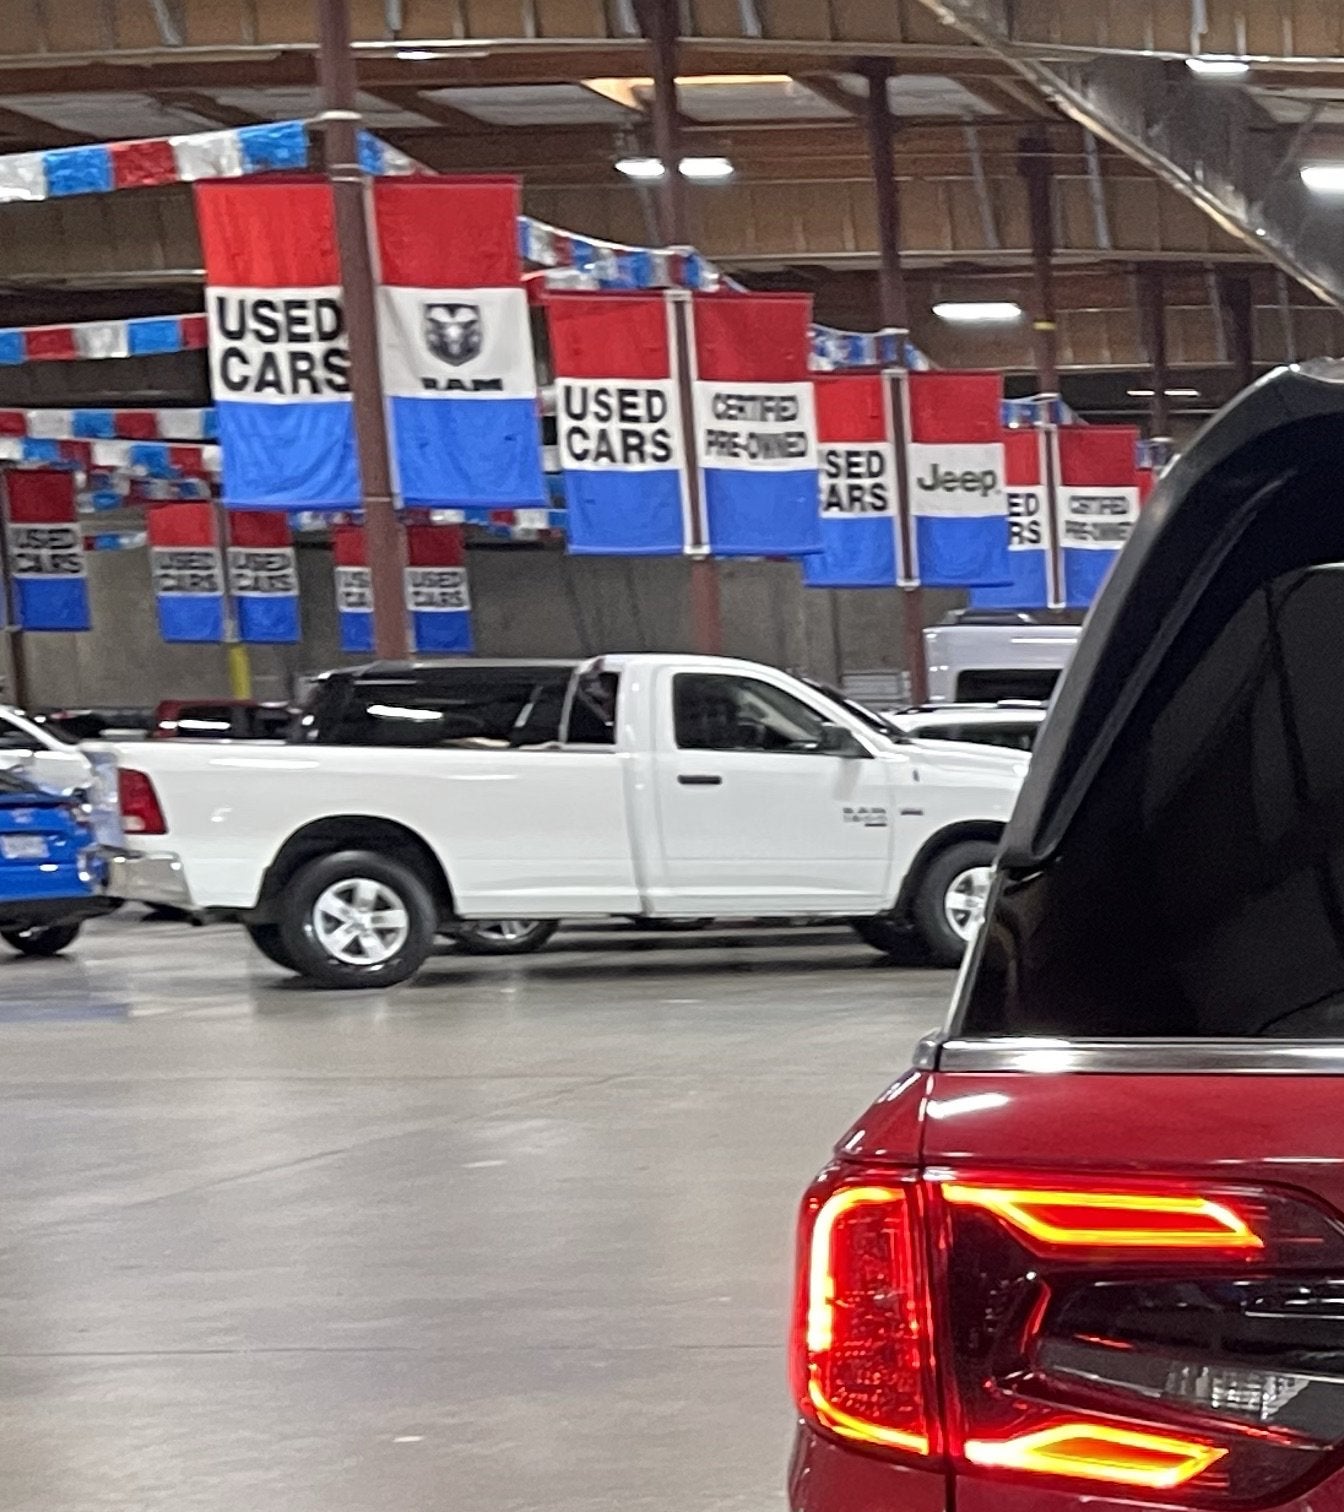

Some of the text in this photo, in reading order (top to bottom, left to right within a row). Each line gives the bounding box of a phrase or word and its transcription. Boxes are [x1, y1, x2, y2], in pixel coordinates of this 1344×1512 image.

[216, 295, 344, 345] USED
[220, 346, 351, 395] CARS
[563, 384, 668, 424] USED
[566, 426, 673, 464] CARS
[825, 449, 886, 479] SED
[916, 463, 998, 498] Jeep
[822, 482, 888, 512] ARS
[1006, 492, 1040, 517] ED
[1006, 519, 1042, 545] RS
